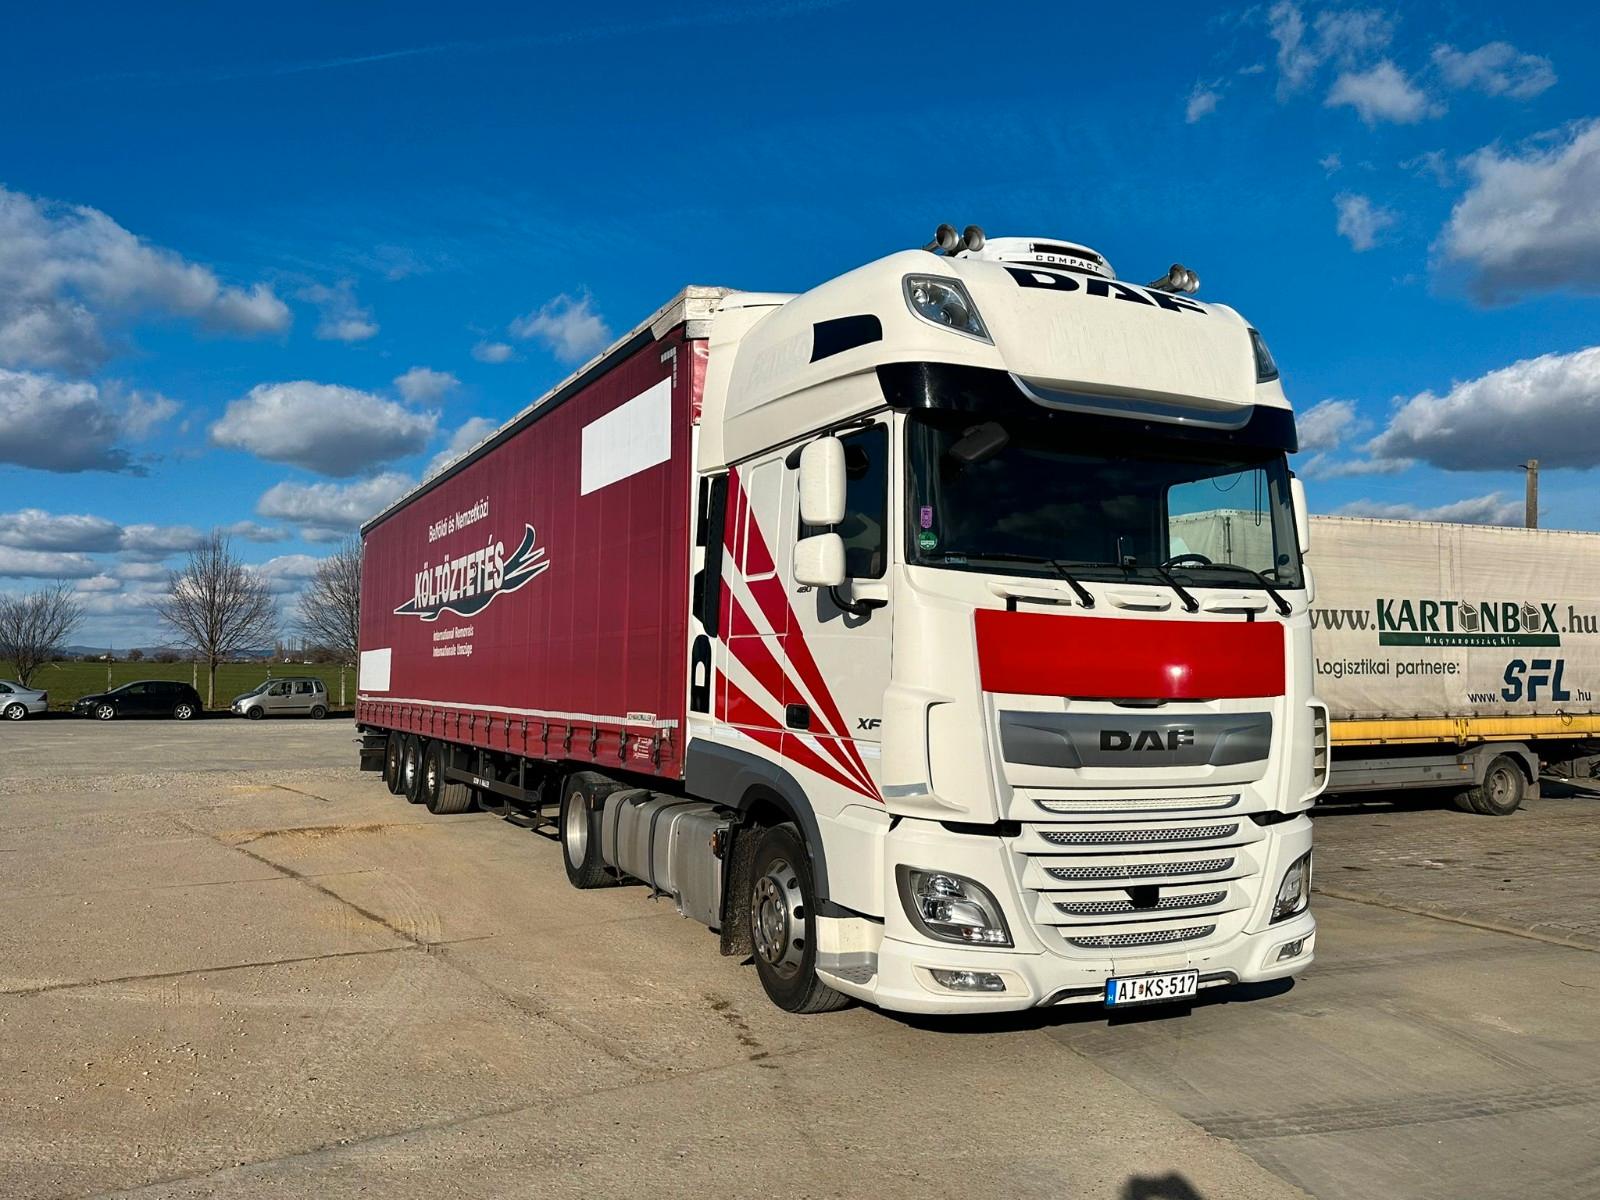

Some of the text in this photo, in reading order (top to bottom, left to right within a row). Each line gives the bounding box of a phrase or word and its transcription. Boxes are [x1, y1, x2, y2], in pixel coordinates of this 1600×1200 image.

[1036, 255, 1100, 272] COMPACT
[1003, 266, 1208, 314] DAF
[414, 534, 504, 609] KÖLTÖZTETÉS
[1316, 658, 1460, 679] Logisztikai partnere:
[856, 717, 882, 730] XF
[1100, 730, 1195, 751] DAF
